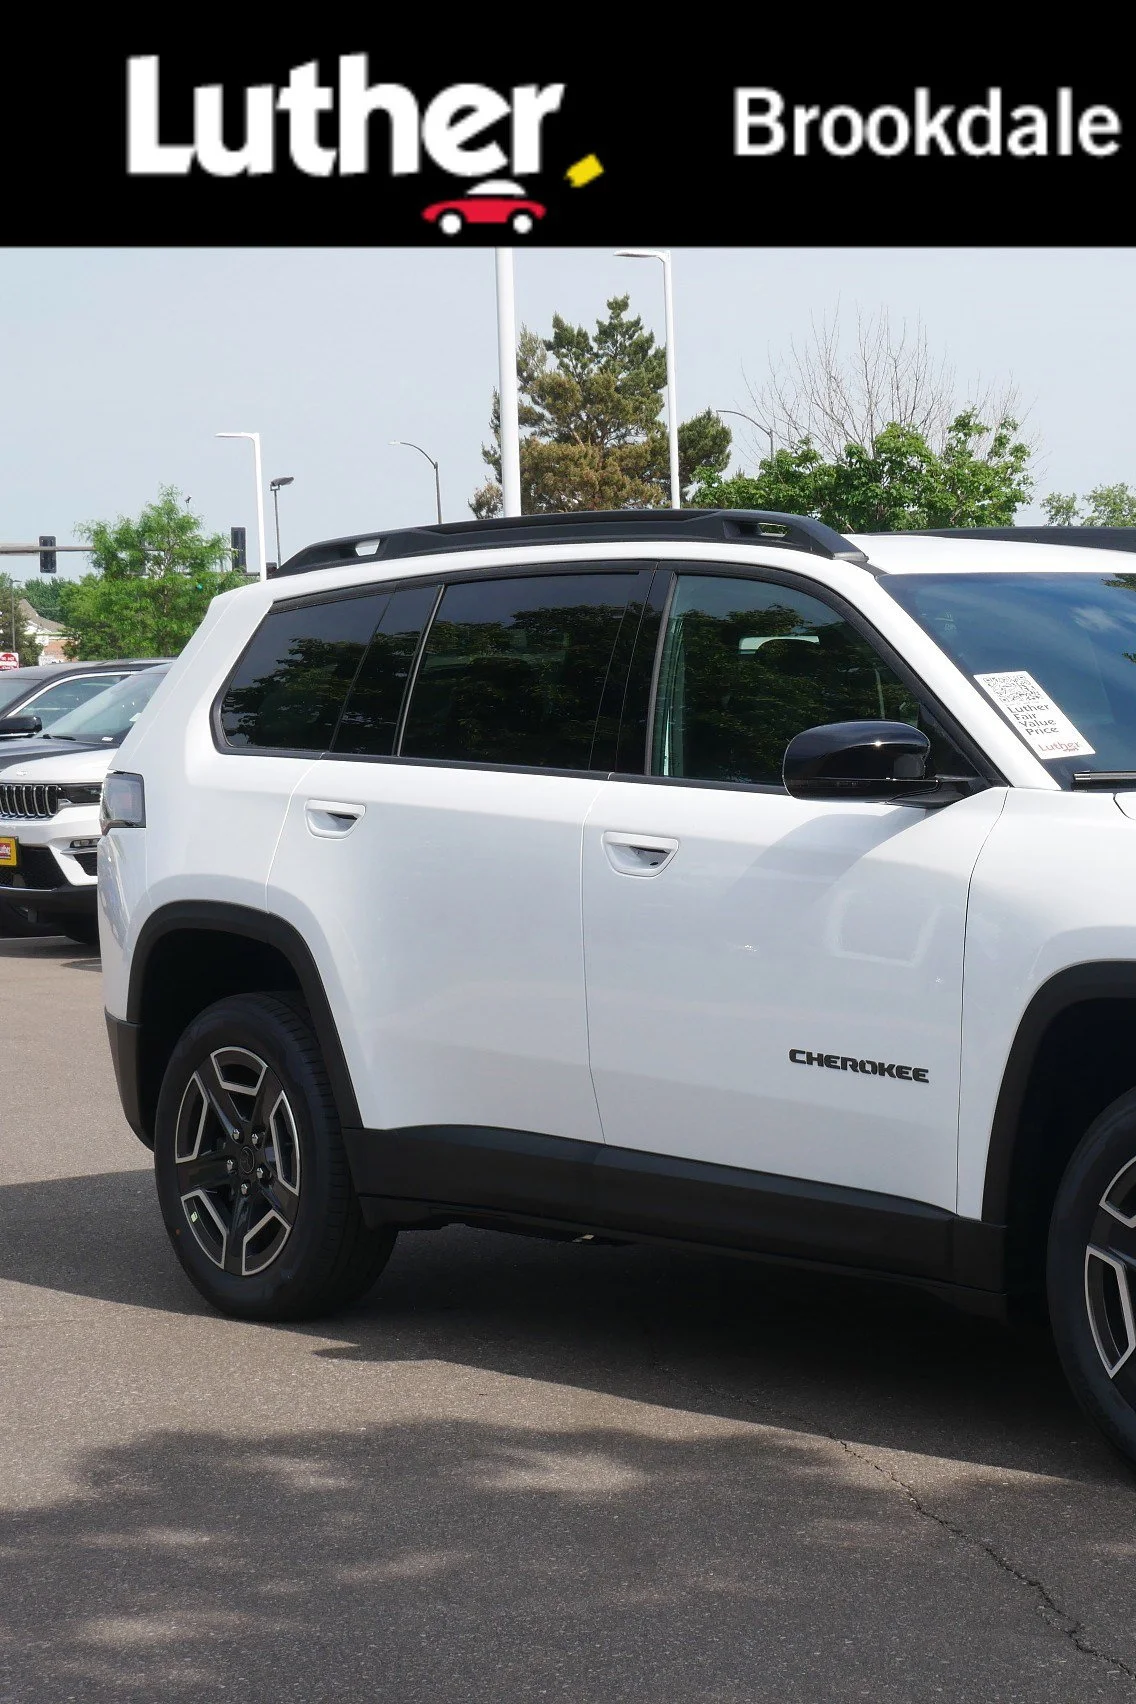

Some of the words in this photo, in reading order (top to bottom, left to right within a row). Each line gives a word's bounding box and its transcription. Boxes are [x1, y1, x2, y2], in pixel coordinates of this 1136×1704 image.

[1006, 704, 1050, 714] Luther
[1013, 712, 1037, 721] Fair
[1018, 719, 1057, 728] Value
[1025, 726, 1060, 736] Price
[1037, 741, 1081, 752] Luther
[788, 1048, 930, 1084] CHEROKEE
